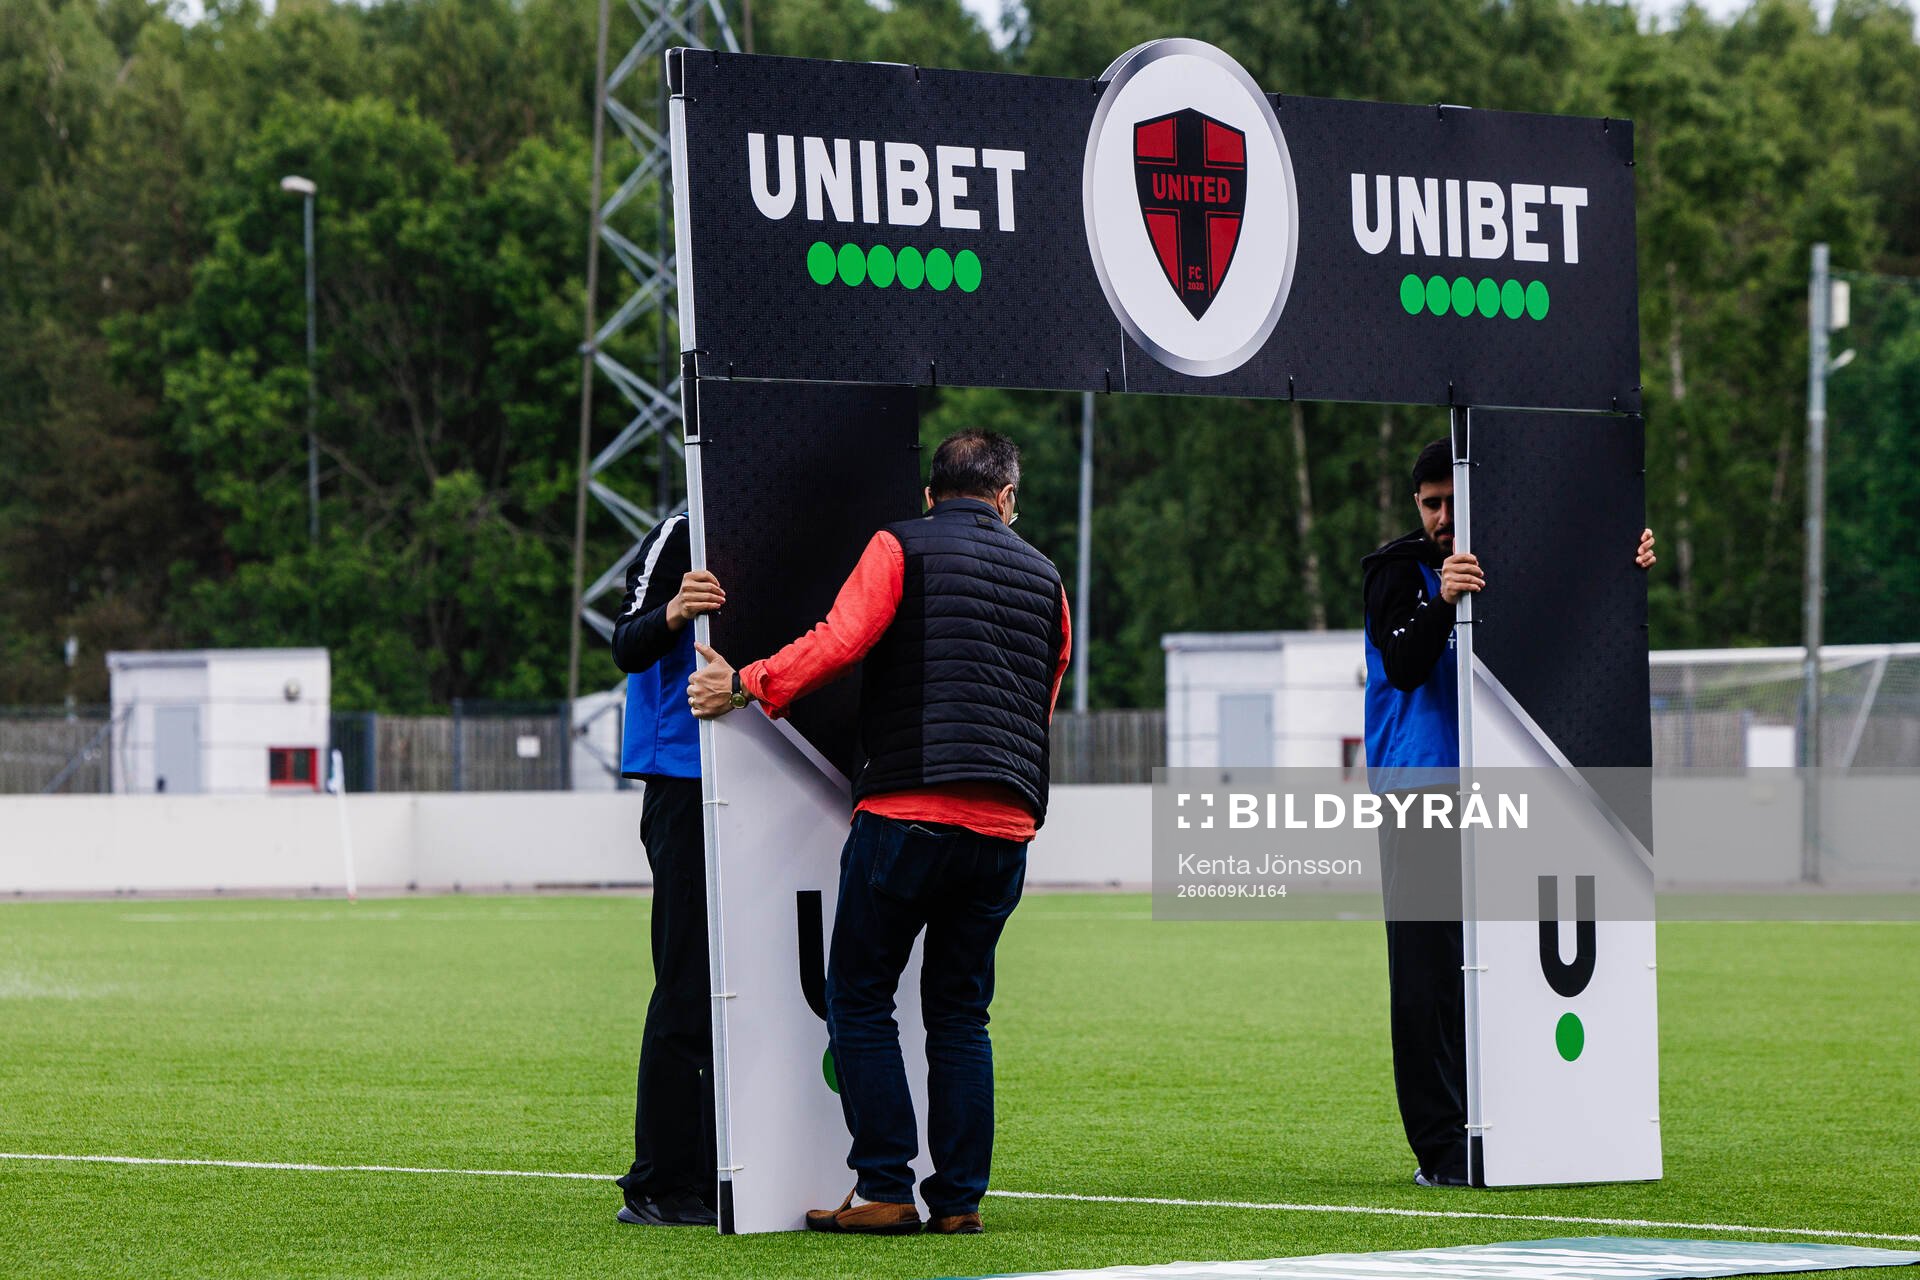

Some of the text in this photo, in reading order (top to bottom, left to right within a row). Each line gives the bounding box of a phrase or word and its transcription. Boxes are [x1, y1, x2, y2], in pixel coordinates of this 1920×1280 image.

[747, 132, 1026, 232] UNIBET
[1153, 173, 1231, 204] UNITED
[1351, 173, 1588, 264] UNIBET
[1187, 282, 1204, 291] 2020
[1188, 265, 1202, 280] FC
[1538, 875, 1597, 998] U
